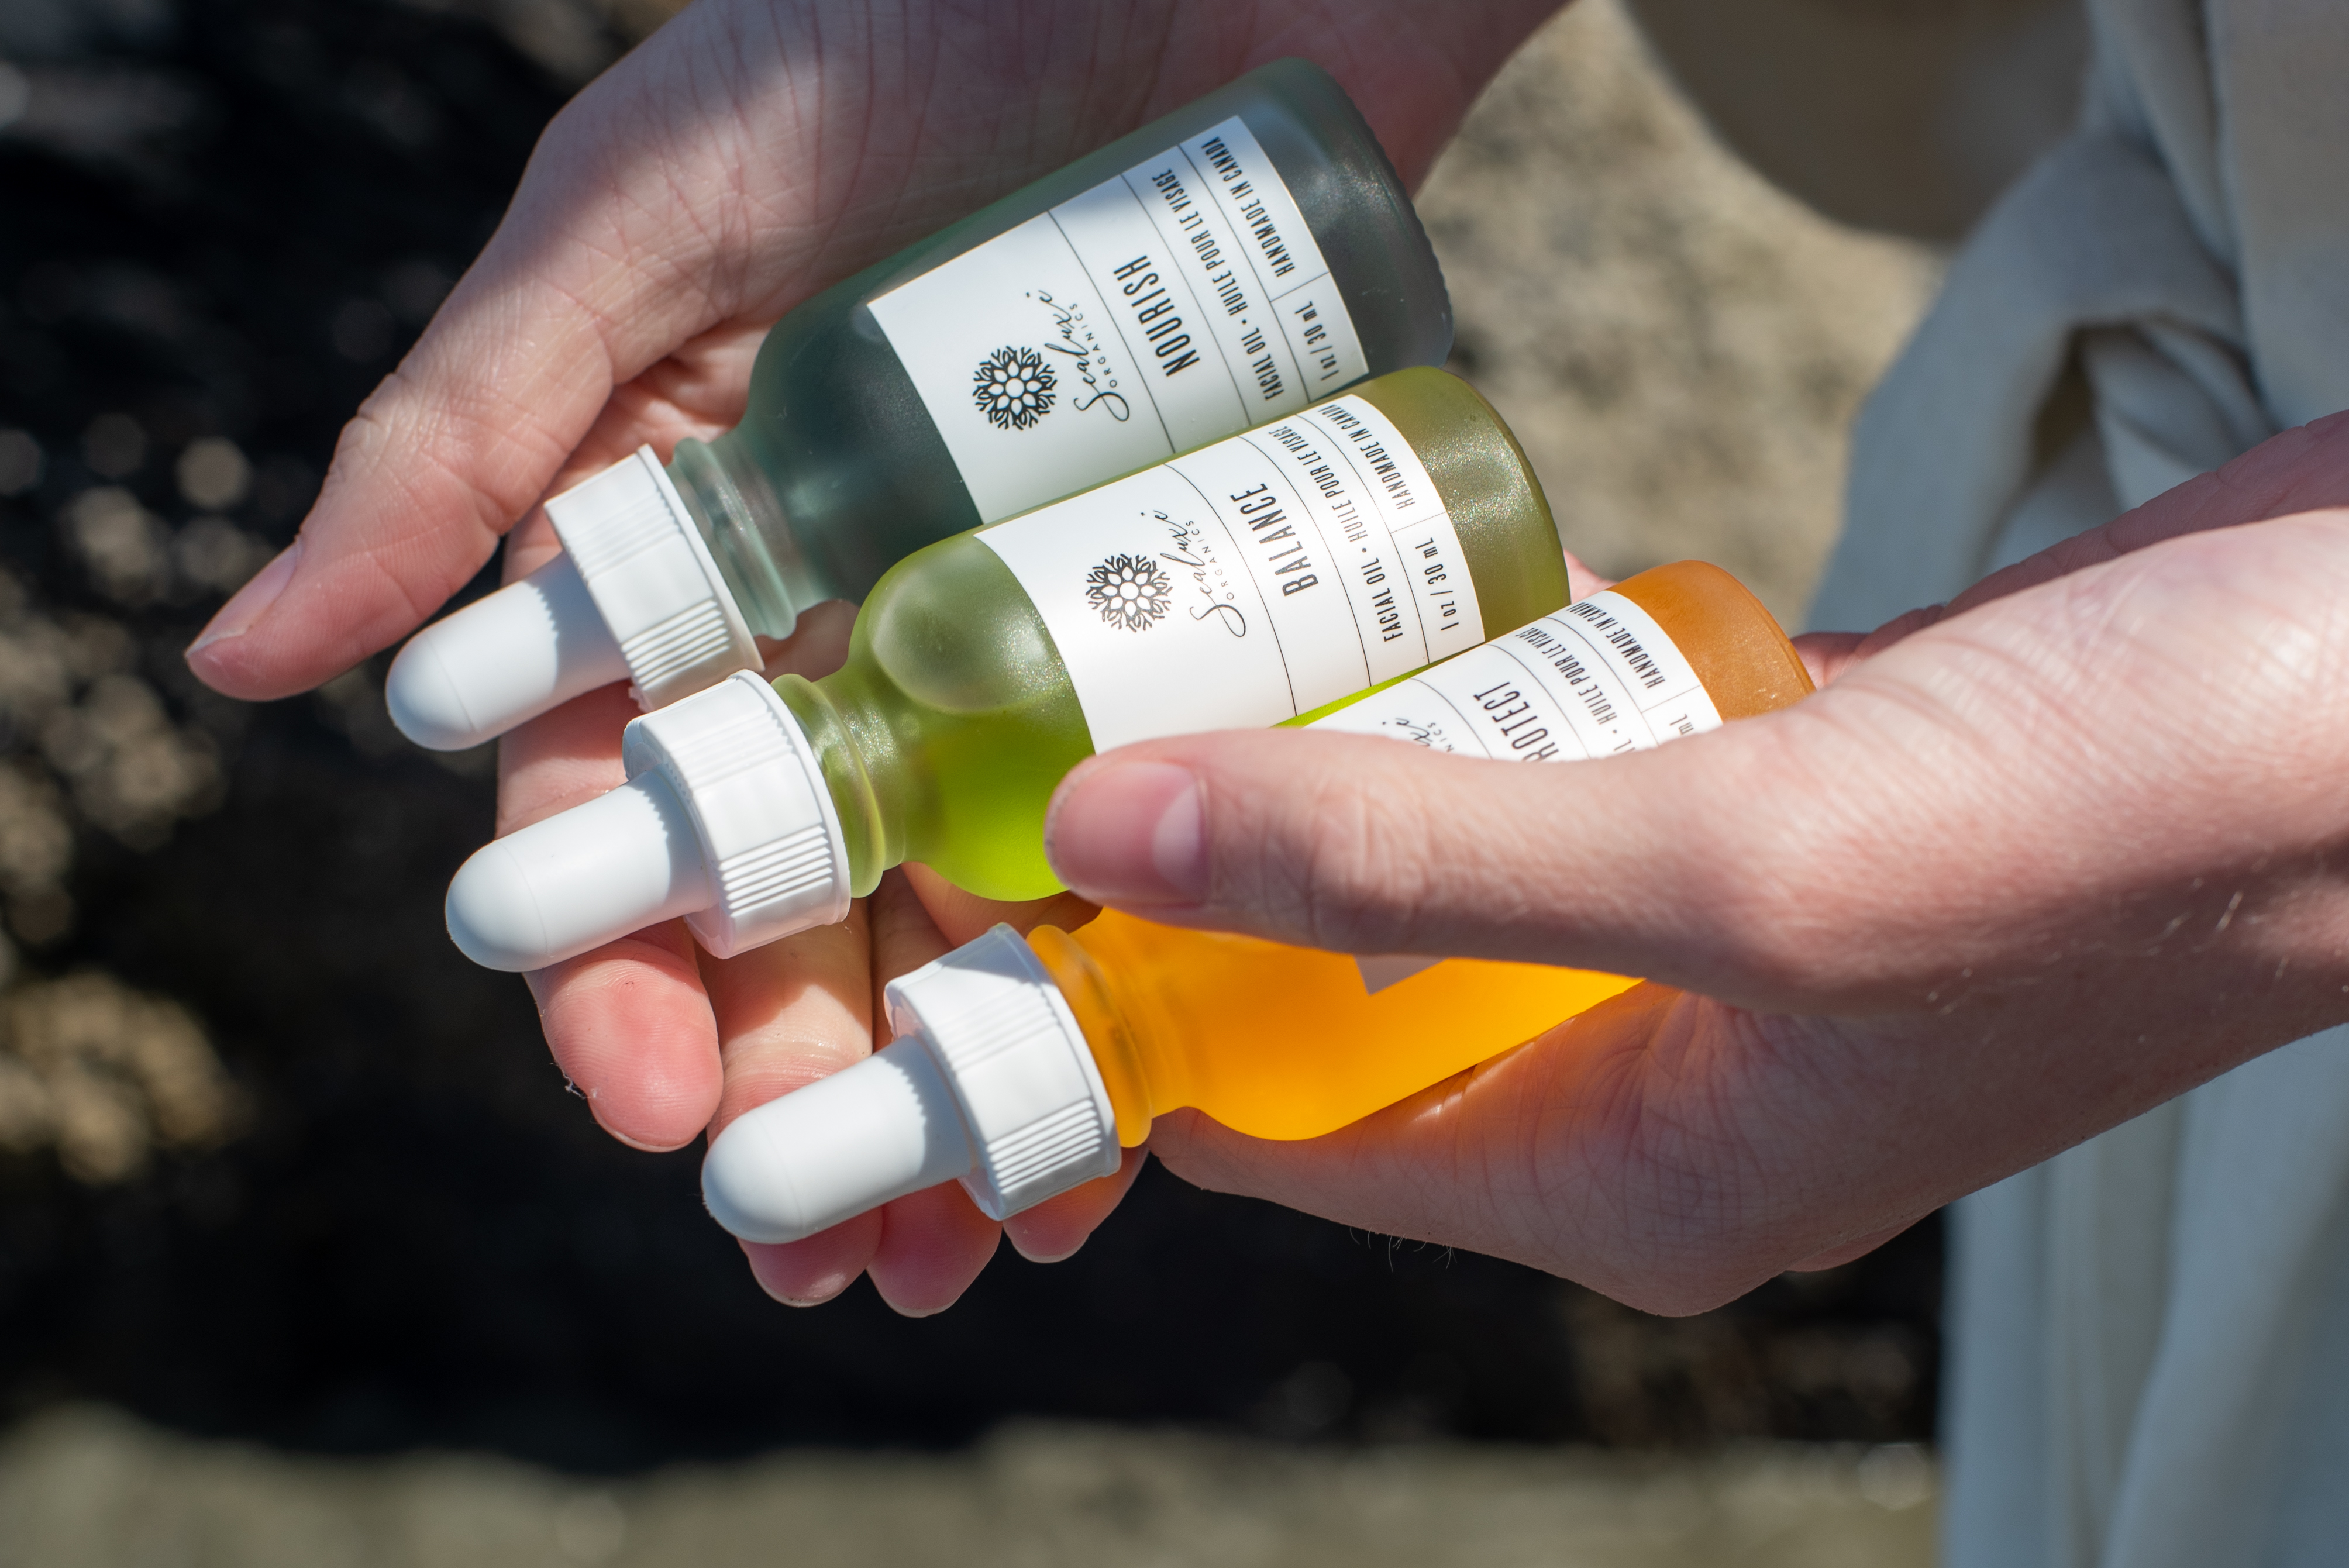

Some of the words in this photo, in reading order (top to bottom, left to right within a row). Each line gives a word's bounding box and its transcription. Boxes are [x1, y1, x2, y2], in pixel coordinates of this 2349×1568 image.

[1201, 136, 1242, 181] CANADA
[1152, 168, 1191, 213] VISAGE
[1229, 180, 1253, 200] IN
[1179, 211, 1203, 231] LE
[1241, 198, 1295, 277] HANDMADE
[1191, 230, 1225, 271] POUR
[1212, 270, 1248, 316] HUILE
[1113, 255, 1200, 377] NOURISH
[1069, 303, 1117, 388] ORGANICS
[1241, 327, 1266, 355] OIL
[1304, 324, 1327, 345] 30
[1252, 354, 1284, 401] FACIAL
[1317, 404, 1361, 430] CANADA
[1268, 426, 1310, 453] VISAGE
[1348, 428, 1372, 442] IN
[1297, 450, 1322, 466] LE
[1310, 464, 1345, 498] POUR
[1359, 441, 1415, 510] HANDMADE
[1332, 499, 1368, 543] HUILE
[1230, 483, 1319, 597] BALANCE
[1186, 521, 1234, 601] ORGANICS
[1361, 557, 1386, 585] OIL
[1424, 564, 1446, 585] 30
[1372, 587, 1403, 642] FACIAL
[1565, 602, 1607, 622] CANADA
[1594, 617, 1618, 632] IN
[1515, 627, 1555, 649] VISAGE
[1542, 644, 1566, 659] LE
[1555, 654, 1591, 685] POUR
[1606, 627, 1666, 689] HANDMADE
[1578, 684, 1617, 725] HUILE
[1427, 722, 1455, 753] NICS
[1473, 681, 1559, 763] ROTECT
